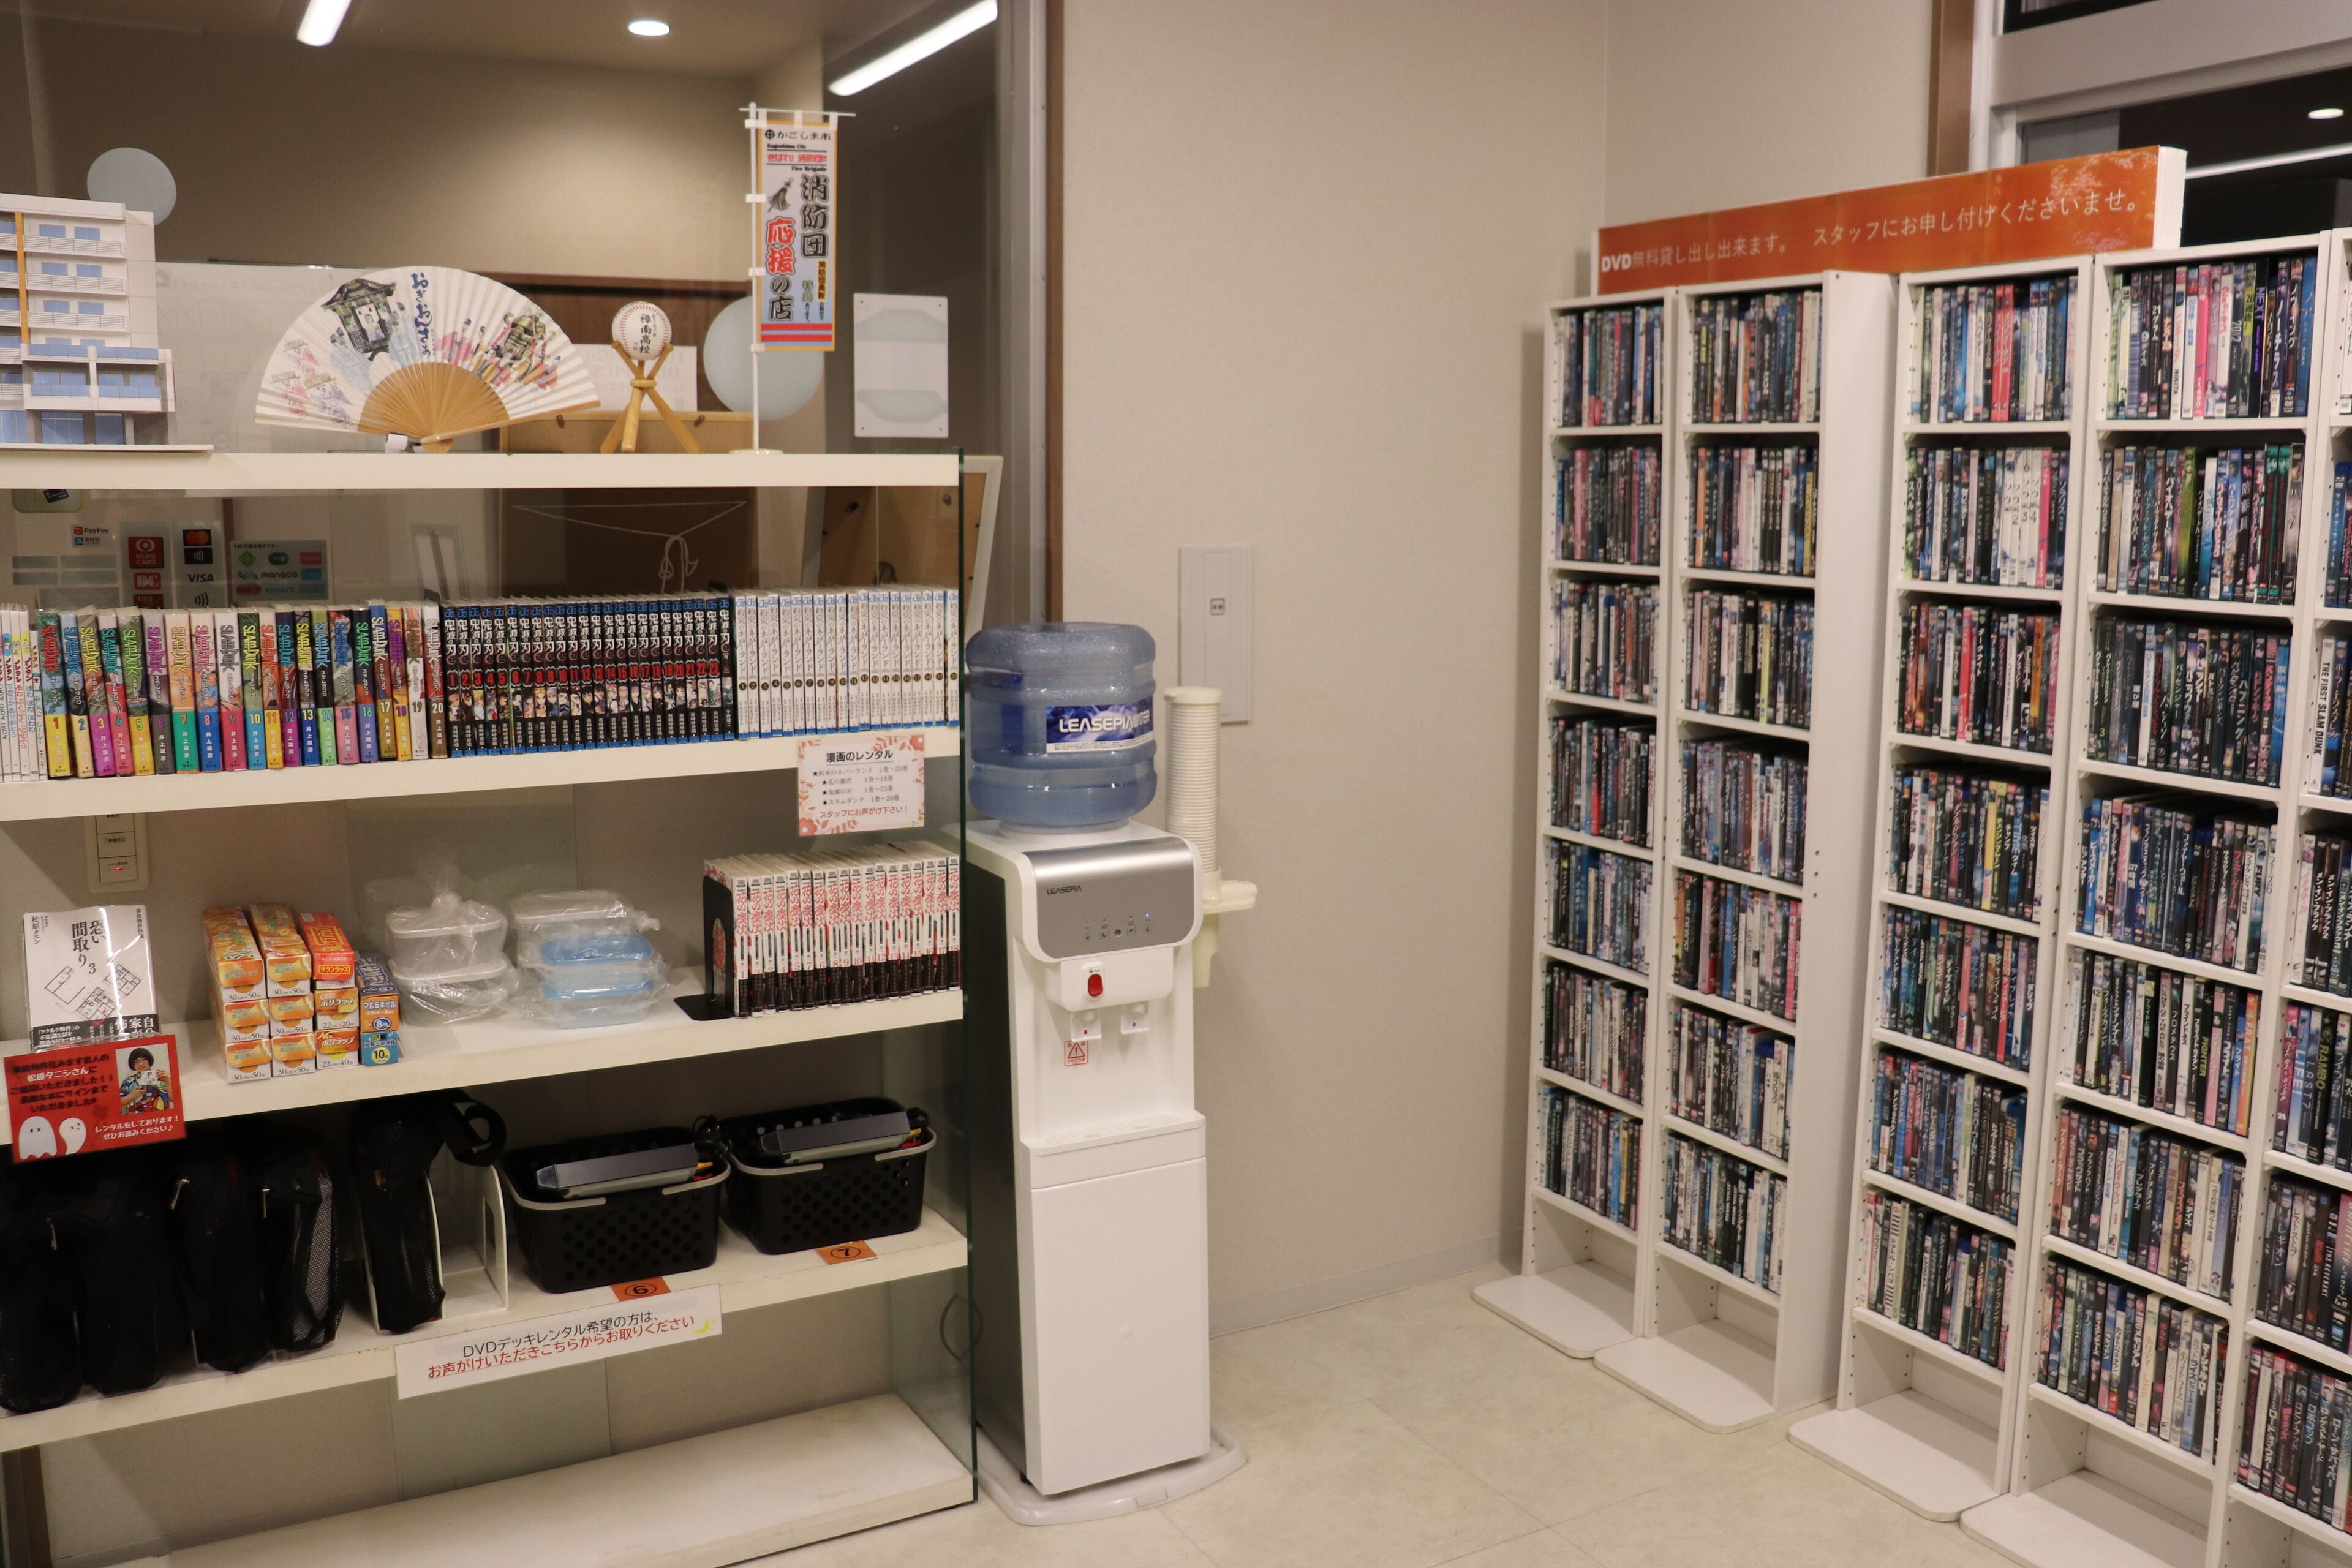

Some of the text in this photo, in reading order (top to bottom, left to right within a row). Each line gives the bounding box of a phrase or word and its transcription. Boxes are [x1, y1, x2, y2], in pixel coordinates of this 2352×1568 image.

[778, 130, 831, 140] かごしま市
[801, 174, 829, 258] 消防団
[1814, 189, 2136, 247] スタッフにお申し付けくださいませ。
[766, 217, 796, 322] 応援の店
[2255, 287, 2264, 320] NEXT
[2288, 283, 2298, 349] ノウイング
[2151, 305, 2162, 341] 21グラム
[2272, 299, 2283, 387] ノーチラス
[2163, 477, 2175, 537] バイオハザード
[2239, 480, 2250, 532] 陪審員
[187, 573, 214, 583] VISA
[708, 660, 719, 674] 23
[1977, 628, 1986, 677] ダークナイト
[449, 673, 456, 687] 1
[53, 717, 59, 729] 1
[97, 718, 105, 729] 3
[136, 718, 143, 730] 5
[181, 714, 187, 725] 7
[249, 713, 261, 725] 10
[302, 709, 313, 720] 13
[380, 701, 391, 712] 17
[432, 702, 443, 714] 20
[2236, 679, 2248, 740] ハプニング
[2313, 662, 2331, 755] THE FIRST SLAM DUNK
[383, 718, 392, 745] 井上雄彦
[826, 750, 894, 763] 漫画のレンタル
[1047, 885, 1082, 895] LEASEPIA
[2254, 864, 2263, 897] FURY
[2311, 872, 2324, 932] メン・イン・ブラック
[32, 916, 40, 944] 松原タニシ
[72, 921, 89, 968] 間取り
[88, 963, 97, 974] 3
[363, 1000, 397, 1009] アルミホイル
[2169, 1011, 2178, 1061] プロメテウス
[27, 1066, 97, 1082] 松原タニシさんに
[2199, 1036, 2210, 1077] FIGHTER
[2292, 1049, 2307, 1096] LIFE!
[2315, 1043, 2330, 1090] RAMBO
[2303, 1060, 2315, 1099] LAST
[2274, 1223, 2287, 1267] レギオン
[2321, 1246, 2335, 1297] THE REVENANT
[428, 1316, 695, 1381] お声がけいただきこちらからお取りください
[463, 1310, 659, 1358] DVDデッキレンタル希望の方は、
[2305, 1403, 2316, 1445] ロボコップ
